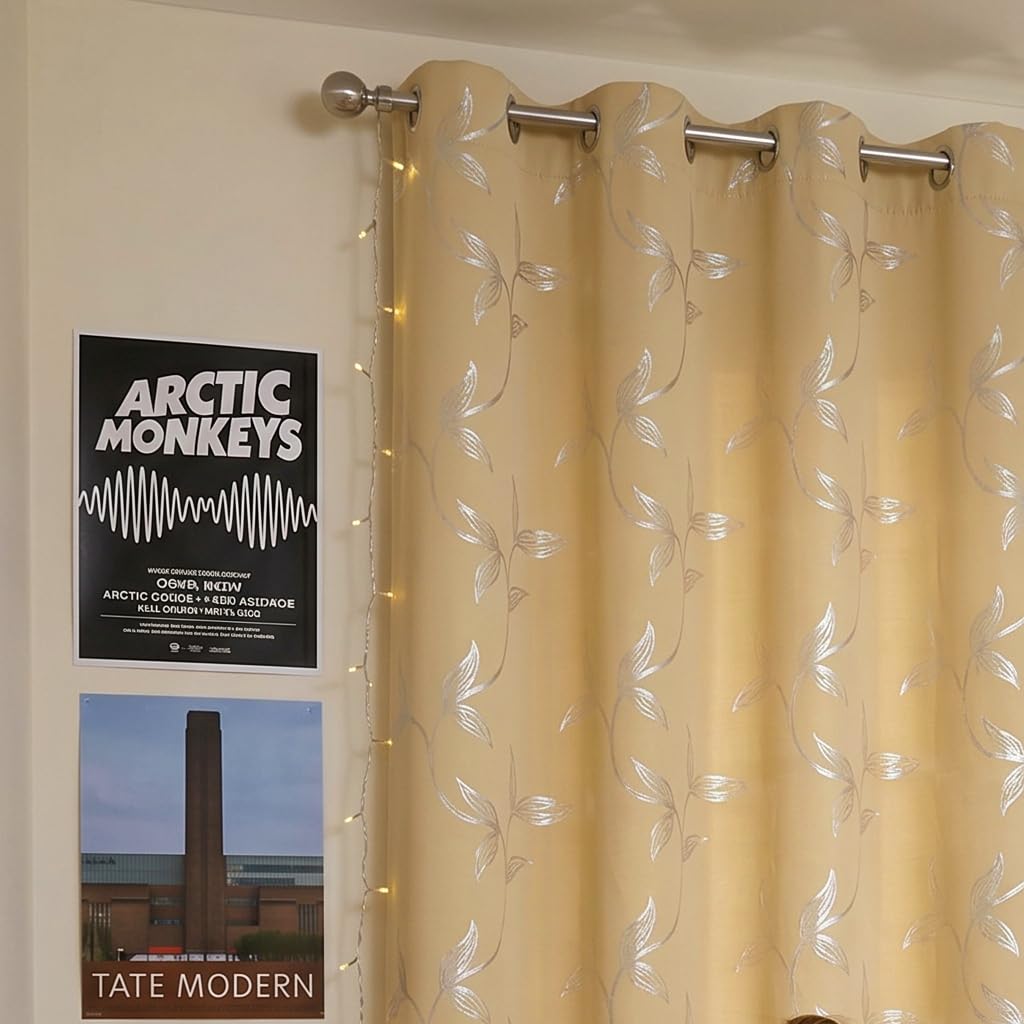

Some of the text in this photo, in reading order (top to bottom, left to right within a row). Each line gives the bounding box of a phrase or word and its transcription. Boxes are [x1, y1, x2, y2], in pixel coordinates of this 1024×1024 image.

[114, 370, 291, 417] ARCTIC
[95, 416, 302, 461] MONKEYS
[103, 590, 148, 602] ARCTIC
[92, 973, 313, 998] TATE MODERN
